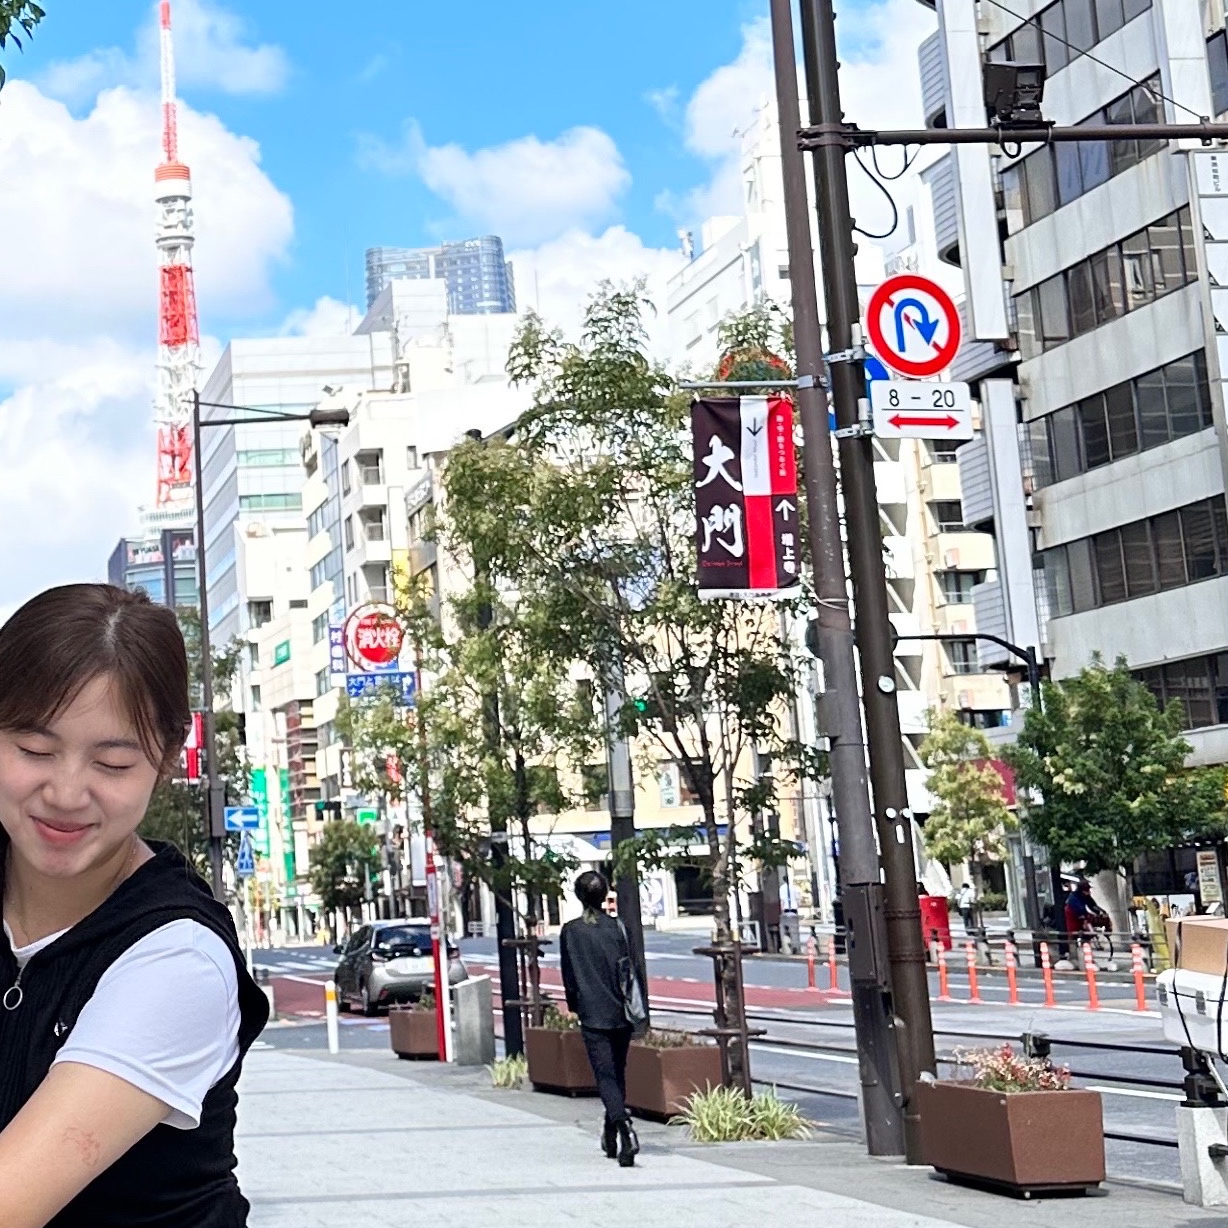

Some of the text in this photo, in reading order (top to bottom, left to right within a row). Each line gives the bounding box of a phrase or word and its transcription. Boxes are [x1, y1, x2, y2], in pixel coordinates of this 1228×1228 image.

[932, 389, 955, 408] 20
[695, 434, 744, 558] 大門
[357, 627, 400, 649] 消火栓
